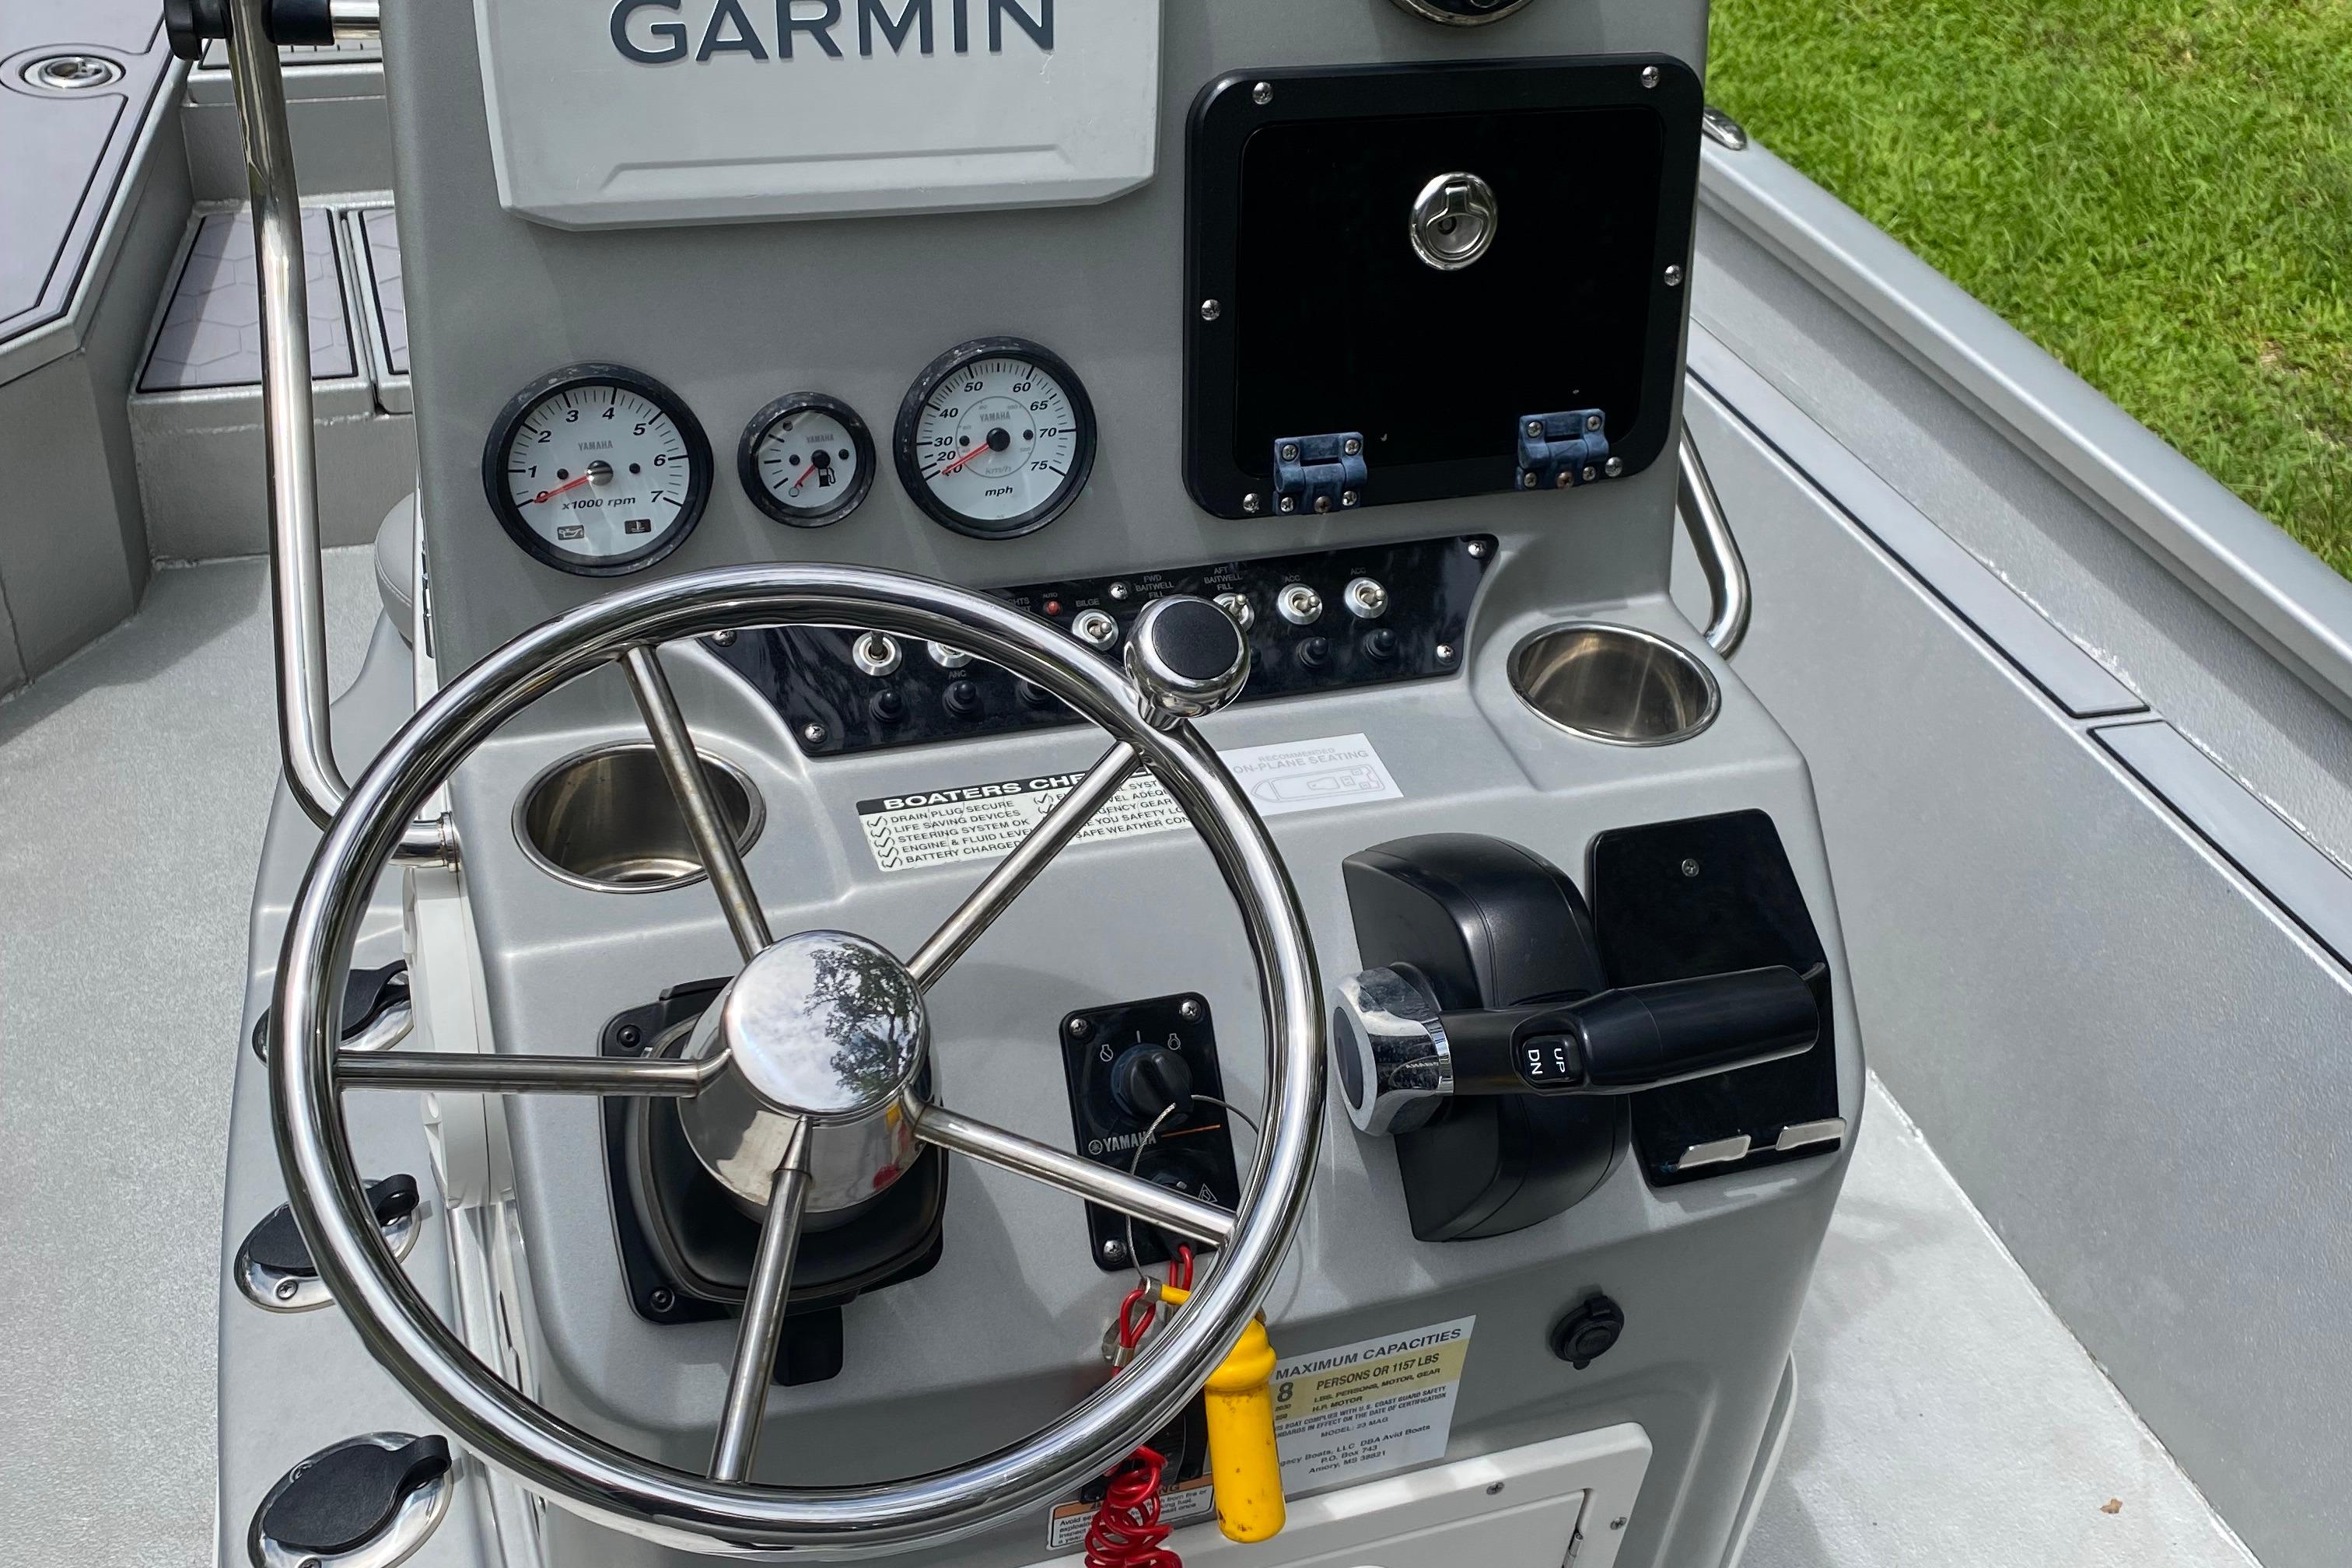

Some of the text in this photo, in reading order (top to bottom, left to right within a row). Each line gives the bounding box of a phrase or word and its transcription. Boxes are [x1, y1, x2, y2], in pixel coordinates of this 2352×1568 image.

[610, 0, 1055, 64] GARMIN
[964, 381, 984, 393] 50
[1013, 382, 1031, 393] 60
[1030, 401, 1048, 411] 65
[565, 410, 579, 422] 3
[602, 407, 615, 420] 4
[939, 408, 959, 419] 40
[979, 411, 1011, 423] YAMAHA
[633, 422, 646, 436] 5
[1039, 428, 1057, 439] 70
[537, 430, 552, 443] 2
[805, 434, 835, 444] YAMAHA
[933, 436, 954, 447] 30
[578, 439, 614, 452] YAMAHA
[653, 453, 667, 467] 6
[936, 450, 957, 462] 20
[528, 465, 537, 478] 1
[1030, 460, 1049, 472] 75
[650, 490, 663, 503] 7
[985, 485, 1014, 498] mph
[562, 495, 636, 510] x1000 rpm
[1213, 566, 1229, 575] AFT
[1143, 574, 1162, 583] FWD
[1204, 572, 1244, 584] BAITWELL
[1135, 580, 1175, 593] BAITWELL
[1216, 582, 1234, 591] FILL
[1076, 597, 1101, 607] BILGE
[1258, 747, 1336, 763] RECOMMENDED
[1233, 750, 1370, 775] ON-PLANE SEATING
[883, 782, 1023, 810] BOATERS
[890, 812, 929, 824] DRAIN
[930, 807, 964, 818] PLUG
[966, 800, 1015, 813] SECURE
[1129, 780, 1157, 790] SYST
[894, 824, 922, 834] LIFE
[922, 817, 968, 830] SAVING
[970, 809, 1021, 823] DEVICES
[898, 829, 959, 843] STEERING
[961, 821, 1010, 835] SYSTEM
[1012, 817, 1031, 828] OK
[1140, 797, 1173, 809] GEAR
[902, 840, 949, 853] ENGINE
[962, 833, 997, 845] FLUID
[1095, 816, 1120, 825] YOU
[1123, 808, 1166, 822] SAFETY
[905, 849, 960, 863] BATTERY
[1075, 828, 1106, 839] SAFE
[1106, 820, 1164, 835] WEATHER
[1528, 1048, 1544, 1076] DN
[1553, 1047, 1566, 1074] UP
[1276, 1328, 1462, 1381] MAXIMUM CAPACITIES
[1277, 1353, 1440, 1403] 8 PERSONS OR 1157 LBS
[1381, 1374, 1414, 1388] MOTOR,
[1416, 1367, 1441, 1379] GEAR
[1304, 1412, 1339, 1425] COMPLIES
[1339, 1406, 1358, 1416] WITH
[1374, 1397, 1397, 1408] COAST
[1398, 1391, 1422, 1403] GUARD
[1422, 1385, 1447, 1397] SAFETY
[1330, 1395, 1363, 1409] MOTOR
[1316, 1416, 1342, 1430] EFFECT
[1355, 1412, 1368, 1420] THE
[1369, 1405, 1387, 1416] DATE
[1388, 1403, 1397, 1412] OF
[1398, 1391, 1447, 1409] CERTIFICATION
[1368, 1416, 1389, 1426] MAG
[1336, 1443, 1356, 1453] LLC
[1360, 1437, 1381, 1447] DBA
[1382, 1430, 1403, 1441] Avid
[1405, 1424, 1431, 1437] Boats
[1341, 1450, 1360, 1459] Box
[1362, 1444, 1378, 1454] 743
[1343, 1457, 1358, 1465] MS
[1059, 1517, 1081, 1527] Avoid
